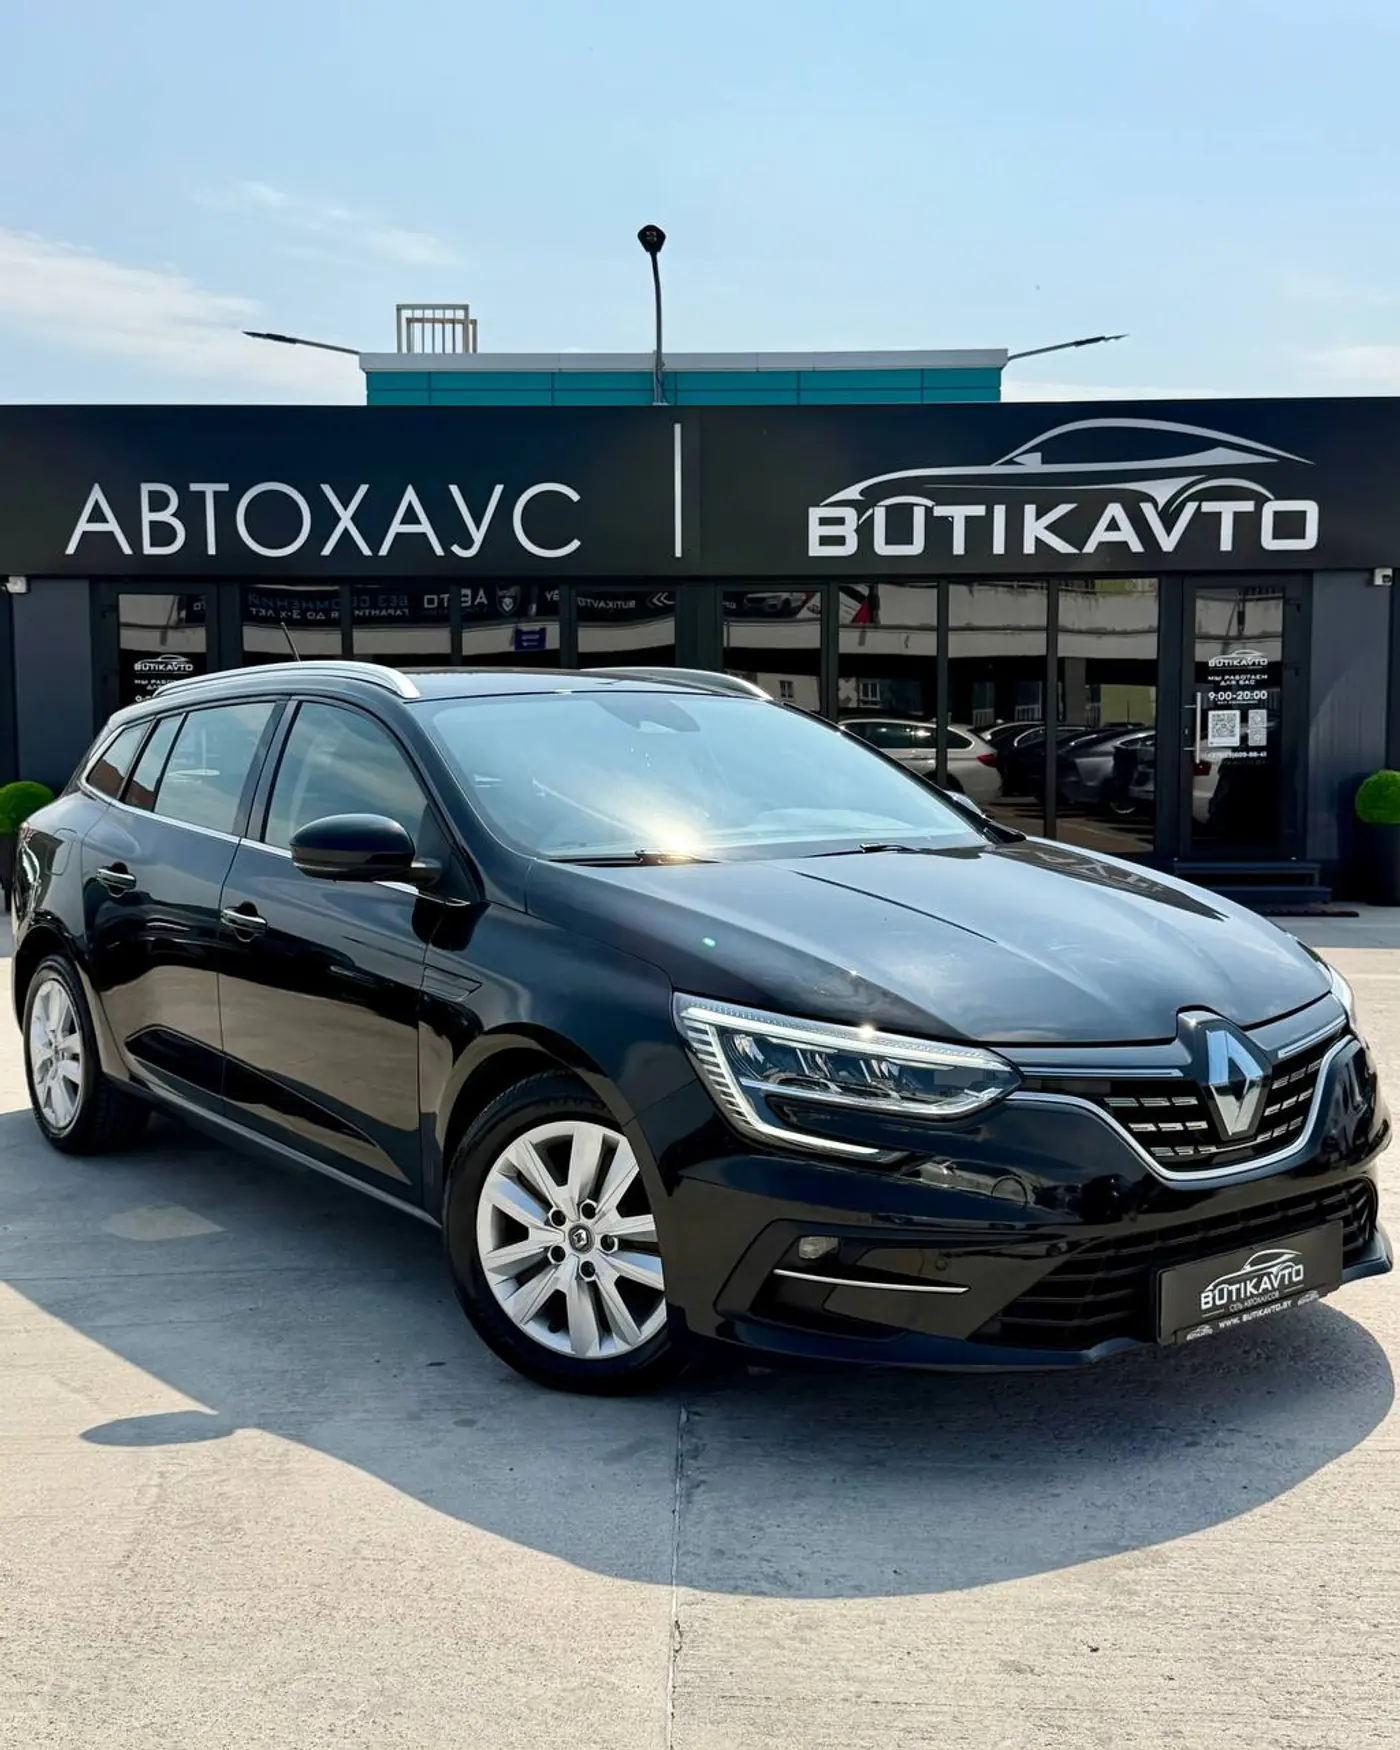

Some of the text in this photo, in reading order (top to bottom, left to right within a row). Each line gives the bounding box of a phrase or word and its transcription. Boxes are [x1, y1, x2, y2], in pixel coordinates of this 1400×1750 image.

[65, 482, 581, 558] АВТОХАУС
[808, 499, 1319, 557] BUTIKAVTO
[1200, 1264, 1305, 1310] BUTIKAVTO
